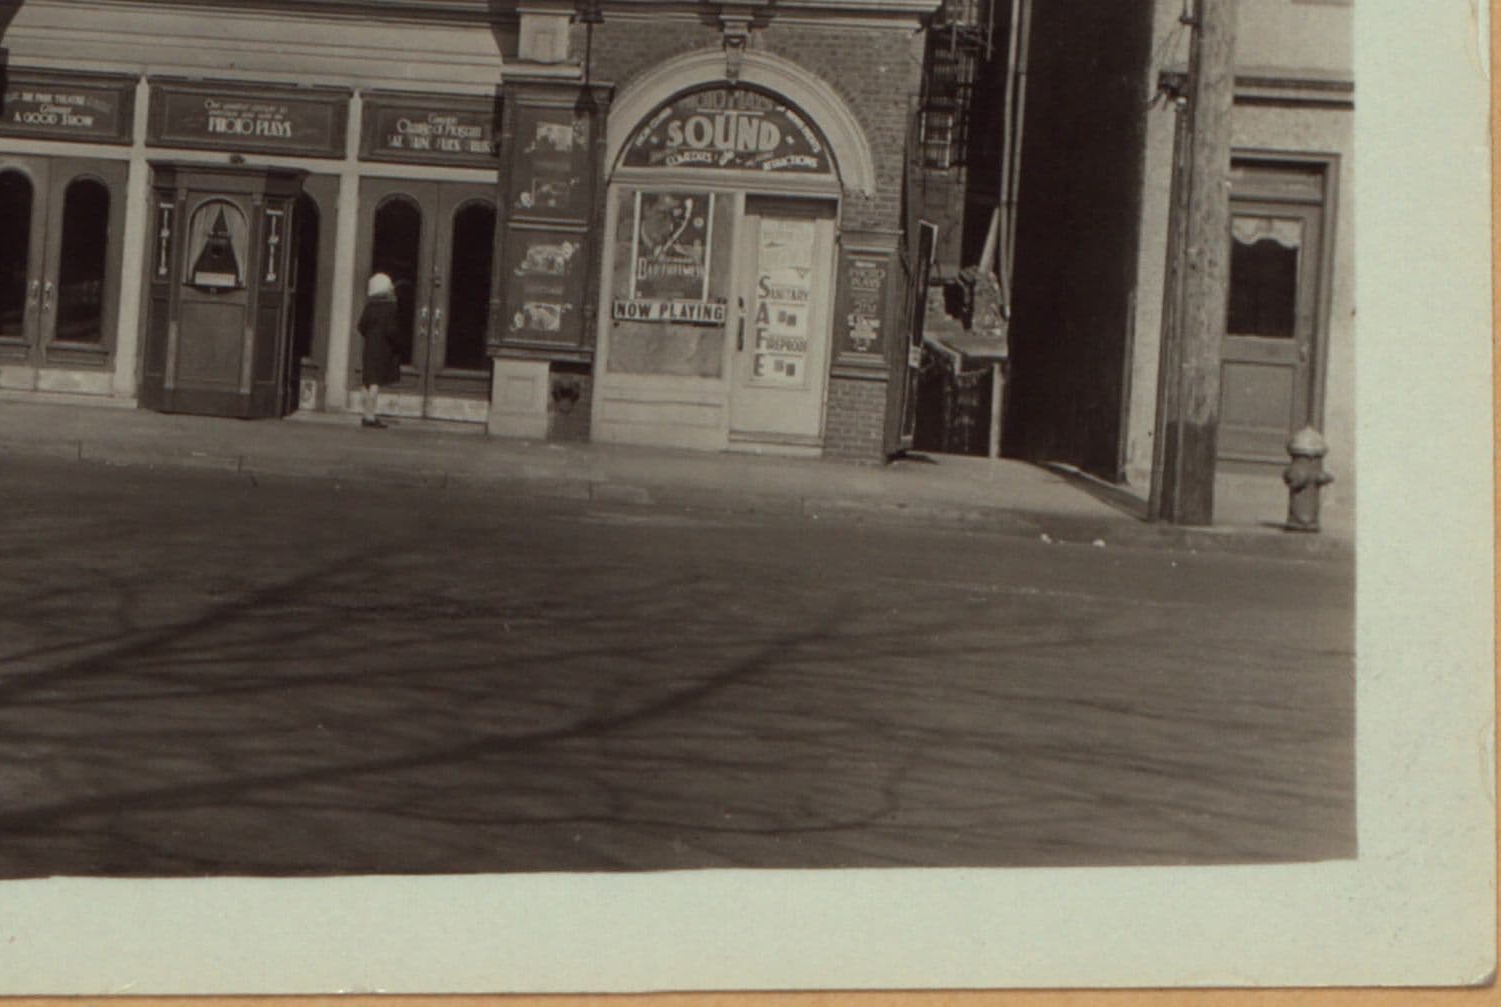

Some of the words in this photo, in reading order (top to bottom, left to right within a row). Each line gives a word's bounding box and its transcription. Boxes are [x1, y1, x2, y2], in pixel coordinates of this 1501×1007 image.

[13, 111, 22, 123] A
[23, 112, 58, 124] GOOD
[60, 112, 94, 127] SHOW
[208, 116, 254, 135] PHOTO
[256, 119, 291, 138] PLAYS
[666, 112, 781, 152] SOUND
[616, 302, 651, 319] NOW
[659, 303, 725, 322] PLAYING
